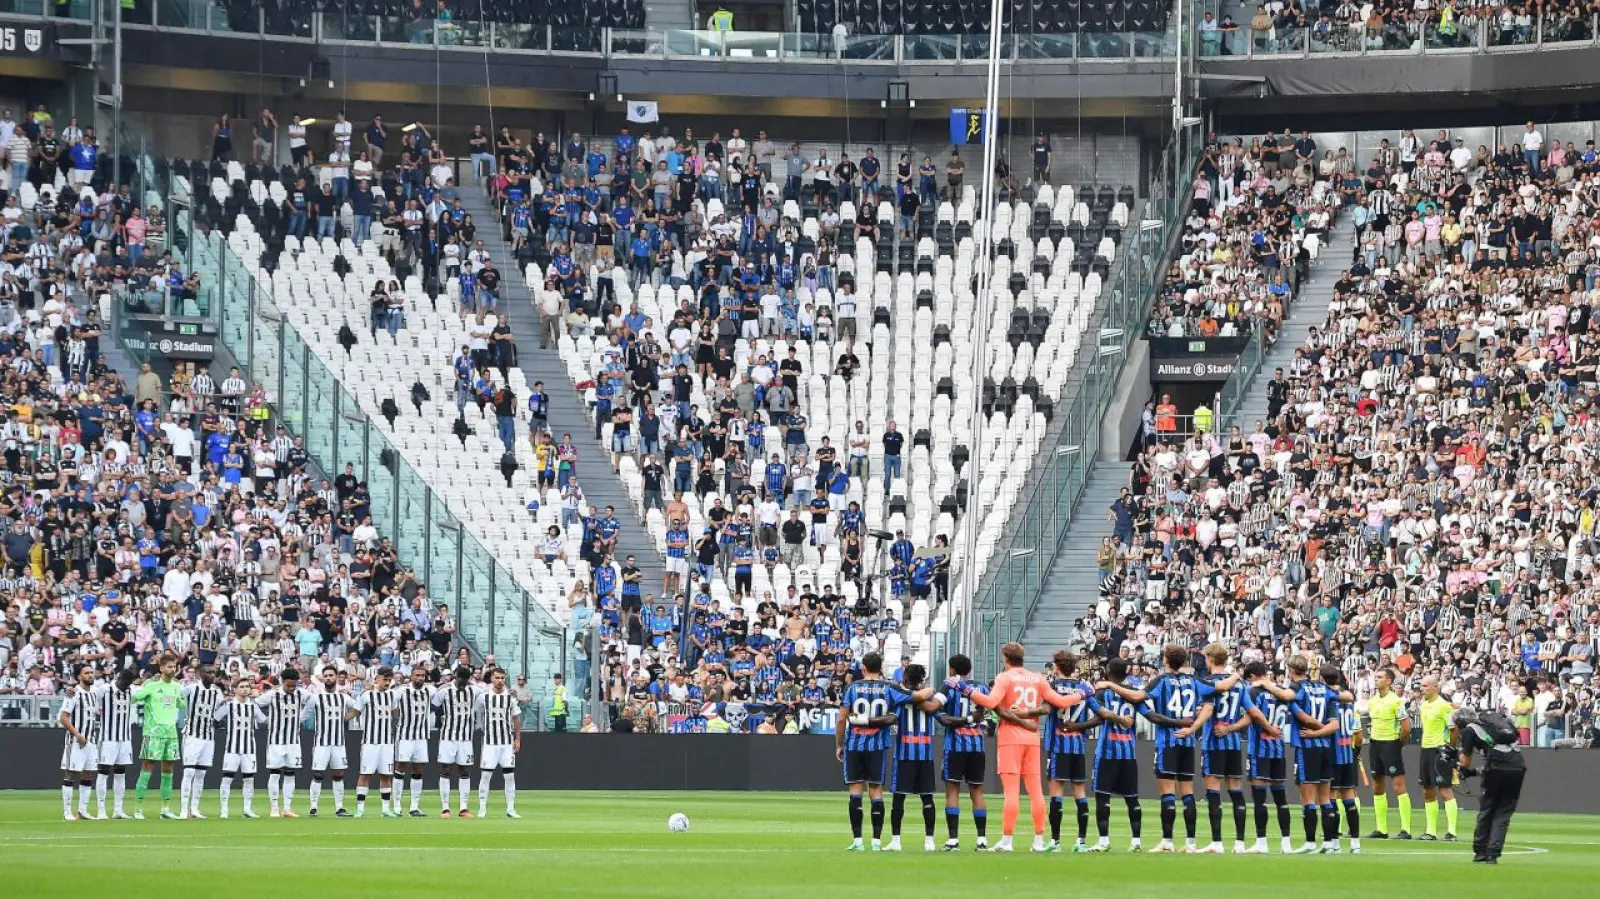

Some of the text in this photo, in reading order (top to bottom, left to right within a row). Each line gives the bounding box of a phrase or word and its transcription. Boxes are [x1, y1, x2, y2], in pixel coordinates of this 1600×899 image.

[173, 341, 213, 352] Stadium
[1158, 364, 1192, 375] Allianz
[1167, 688, 1196, 717] 42
[1266, 703, 1289, 730] 16
[1309, 695, 1326, 724] 17
[904, 703, 926, 732] 11
[1338, 708, 1354, 736] 10
